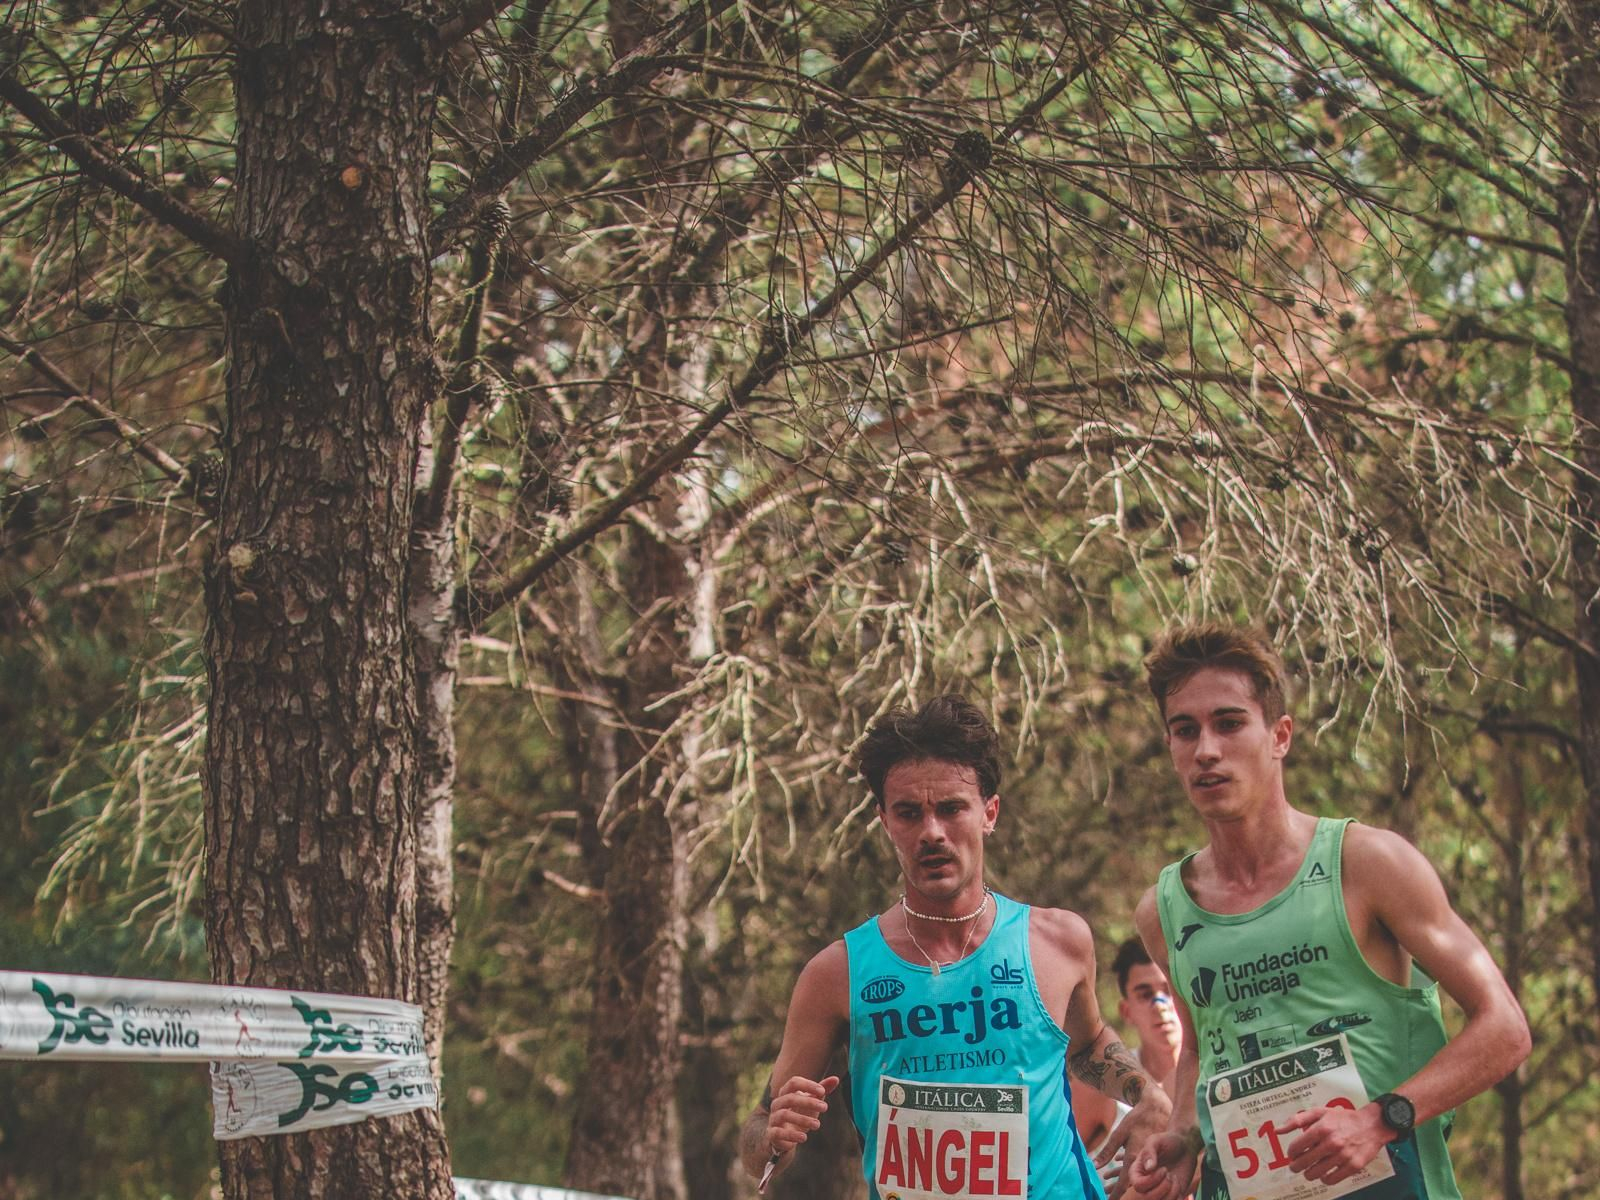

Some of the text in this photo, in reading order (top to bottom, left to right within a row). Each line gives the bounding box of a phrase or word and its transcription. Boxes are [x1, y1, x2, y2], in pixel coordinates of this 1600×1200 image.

[1221, 943, 1328, 984] Fundación
[863, 981, 903, 1000] TROPS
[1224, 970, 1300, 1002] Unicaja
[869, 986, 1023, 1045] nerja
[1233, 1006, 1262, 1024] Jaén
[121, 1019, 200, 1048] Sevilla
[899, 1048, 1006, 1075] ATLETISMO
[1238, 1059, 1306, 1092] ITÁLICA
[915, 1088, 986, 1108] ITÁLICA
[879, 1108, 1022, 1196] ÁNGEL
